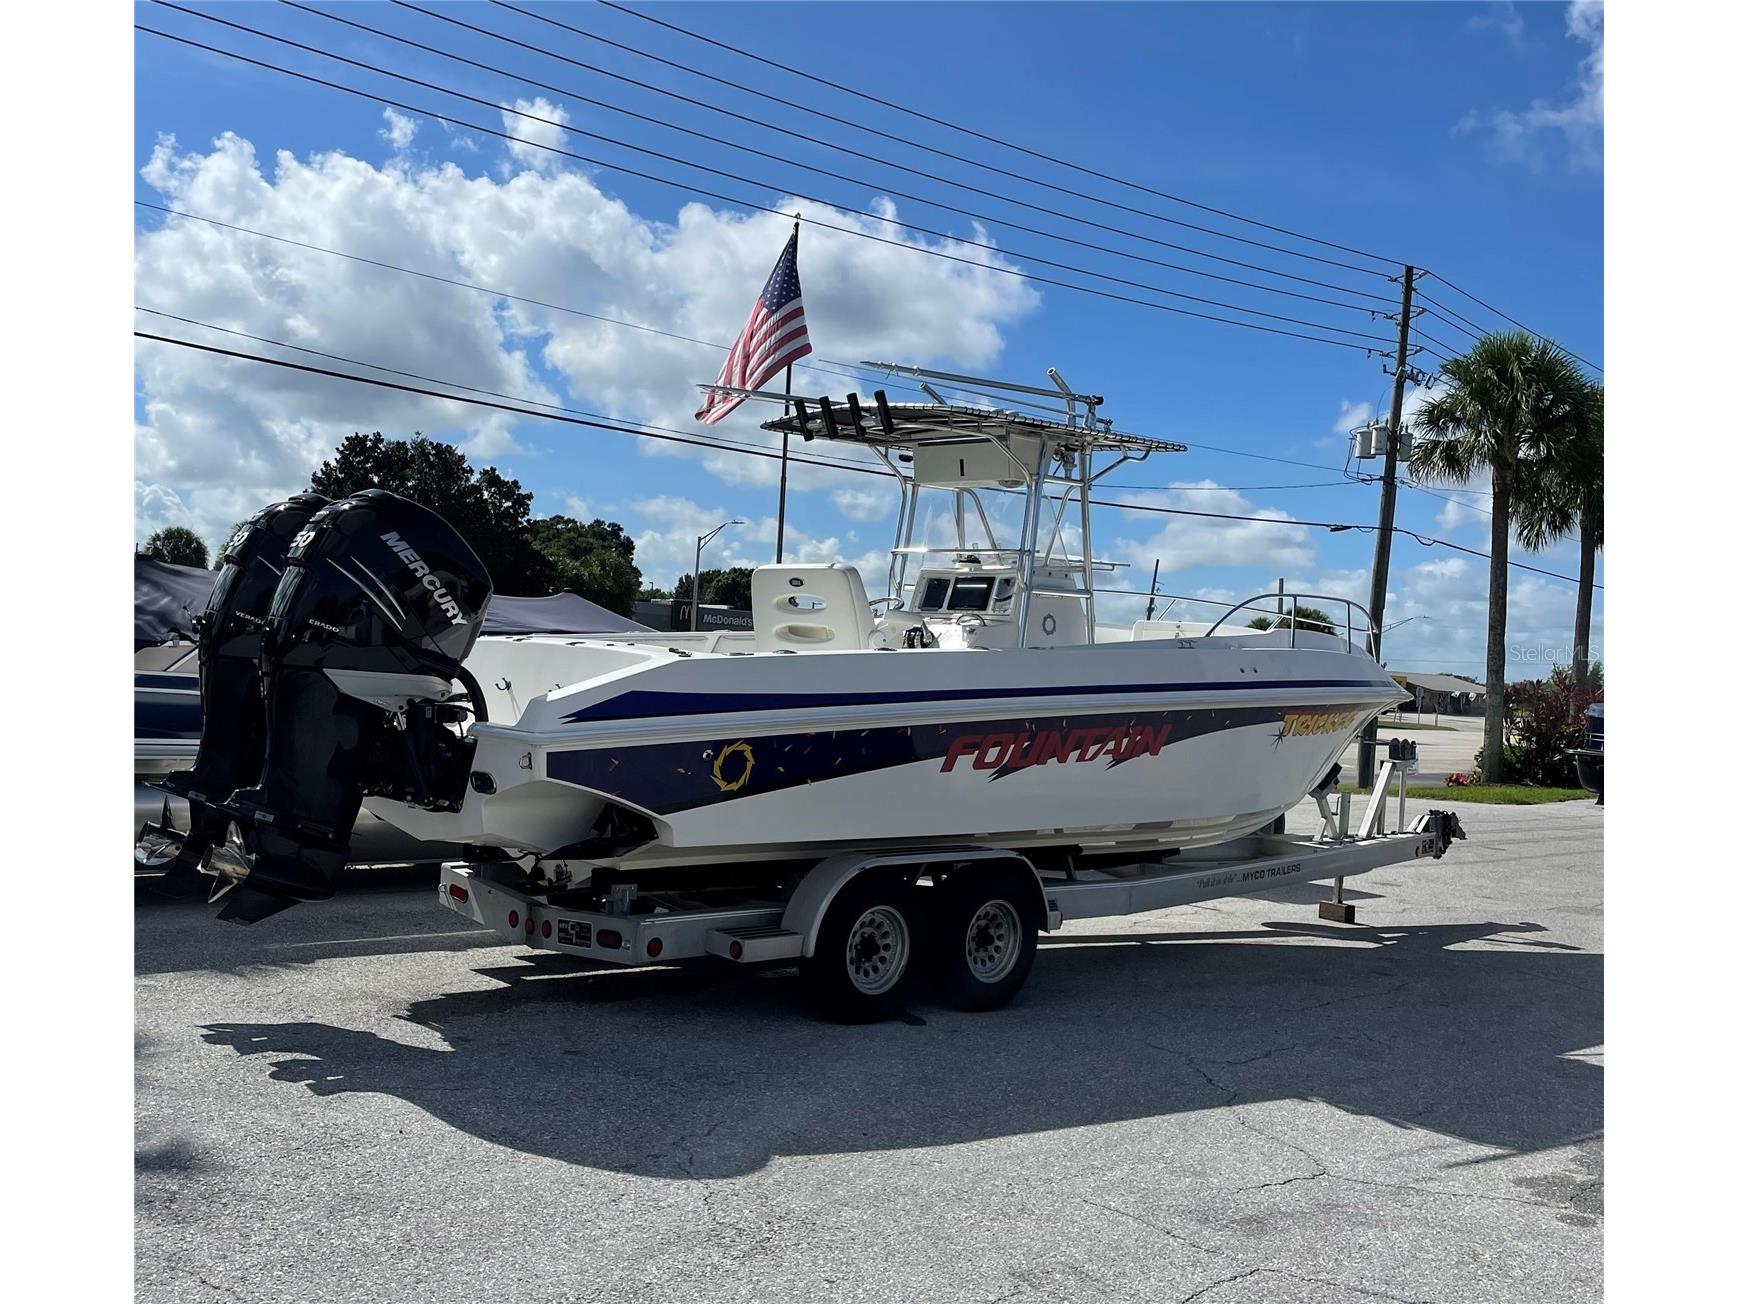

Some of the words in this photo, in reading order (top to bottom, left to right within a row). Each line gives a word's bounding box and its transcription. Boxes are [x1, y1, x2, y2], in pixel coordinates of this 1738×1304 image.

[380, 531, 468, 625] MERCURY
[308, 619, 339, 632] ERADO
[703, 614, 752, 626] McDonald's
[939, 724, 1173, 773] FOUNTAIN
[1267, 864, 1300, 878] TRAILERS
